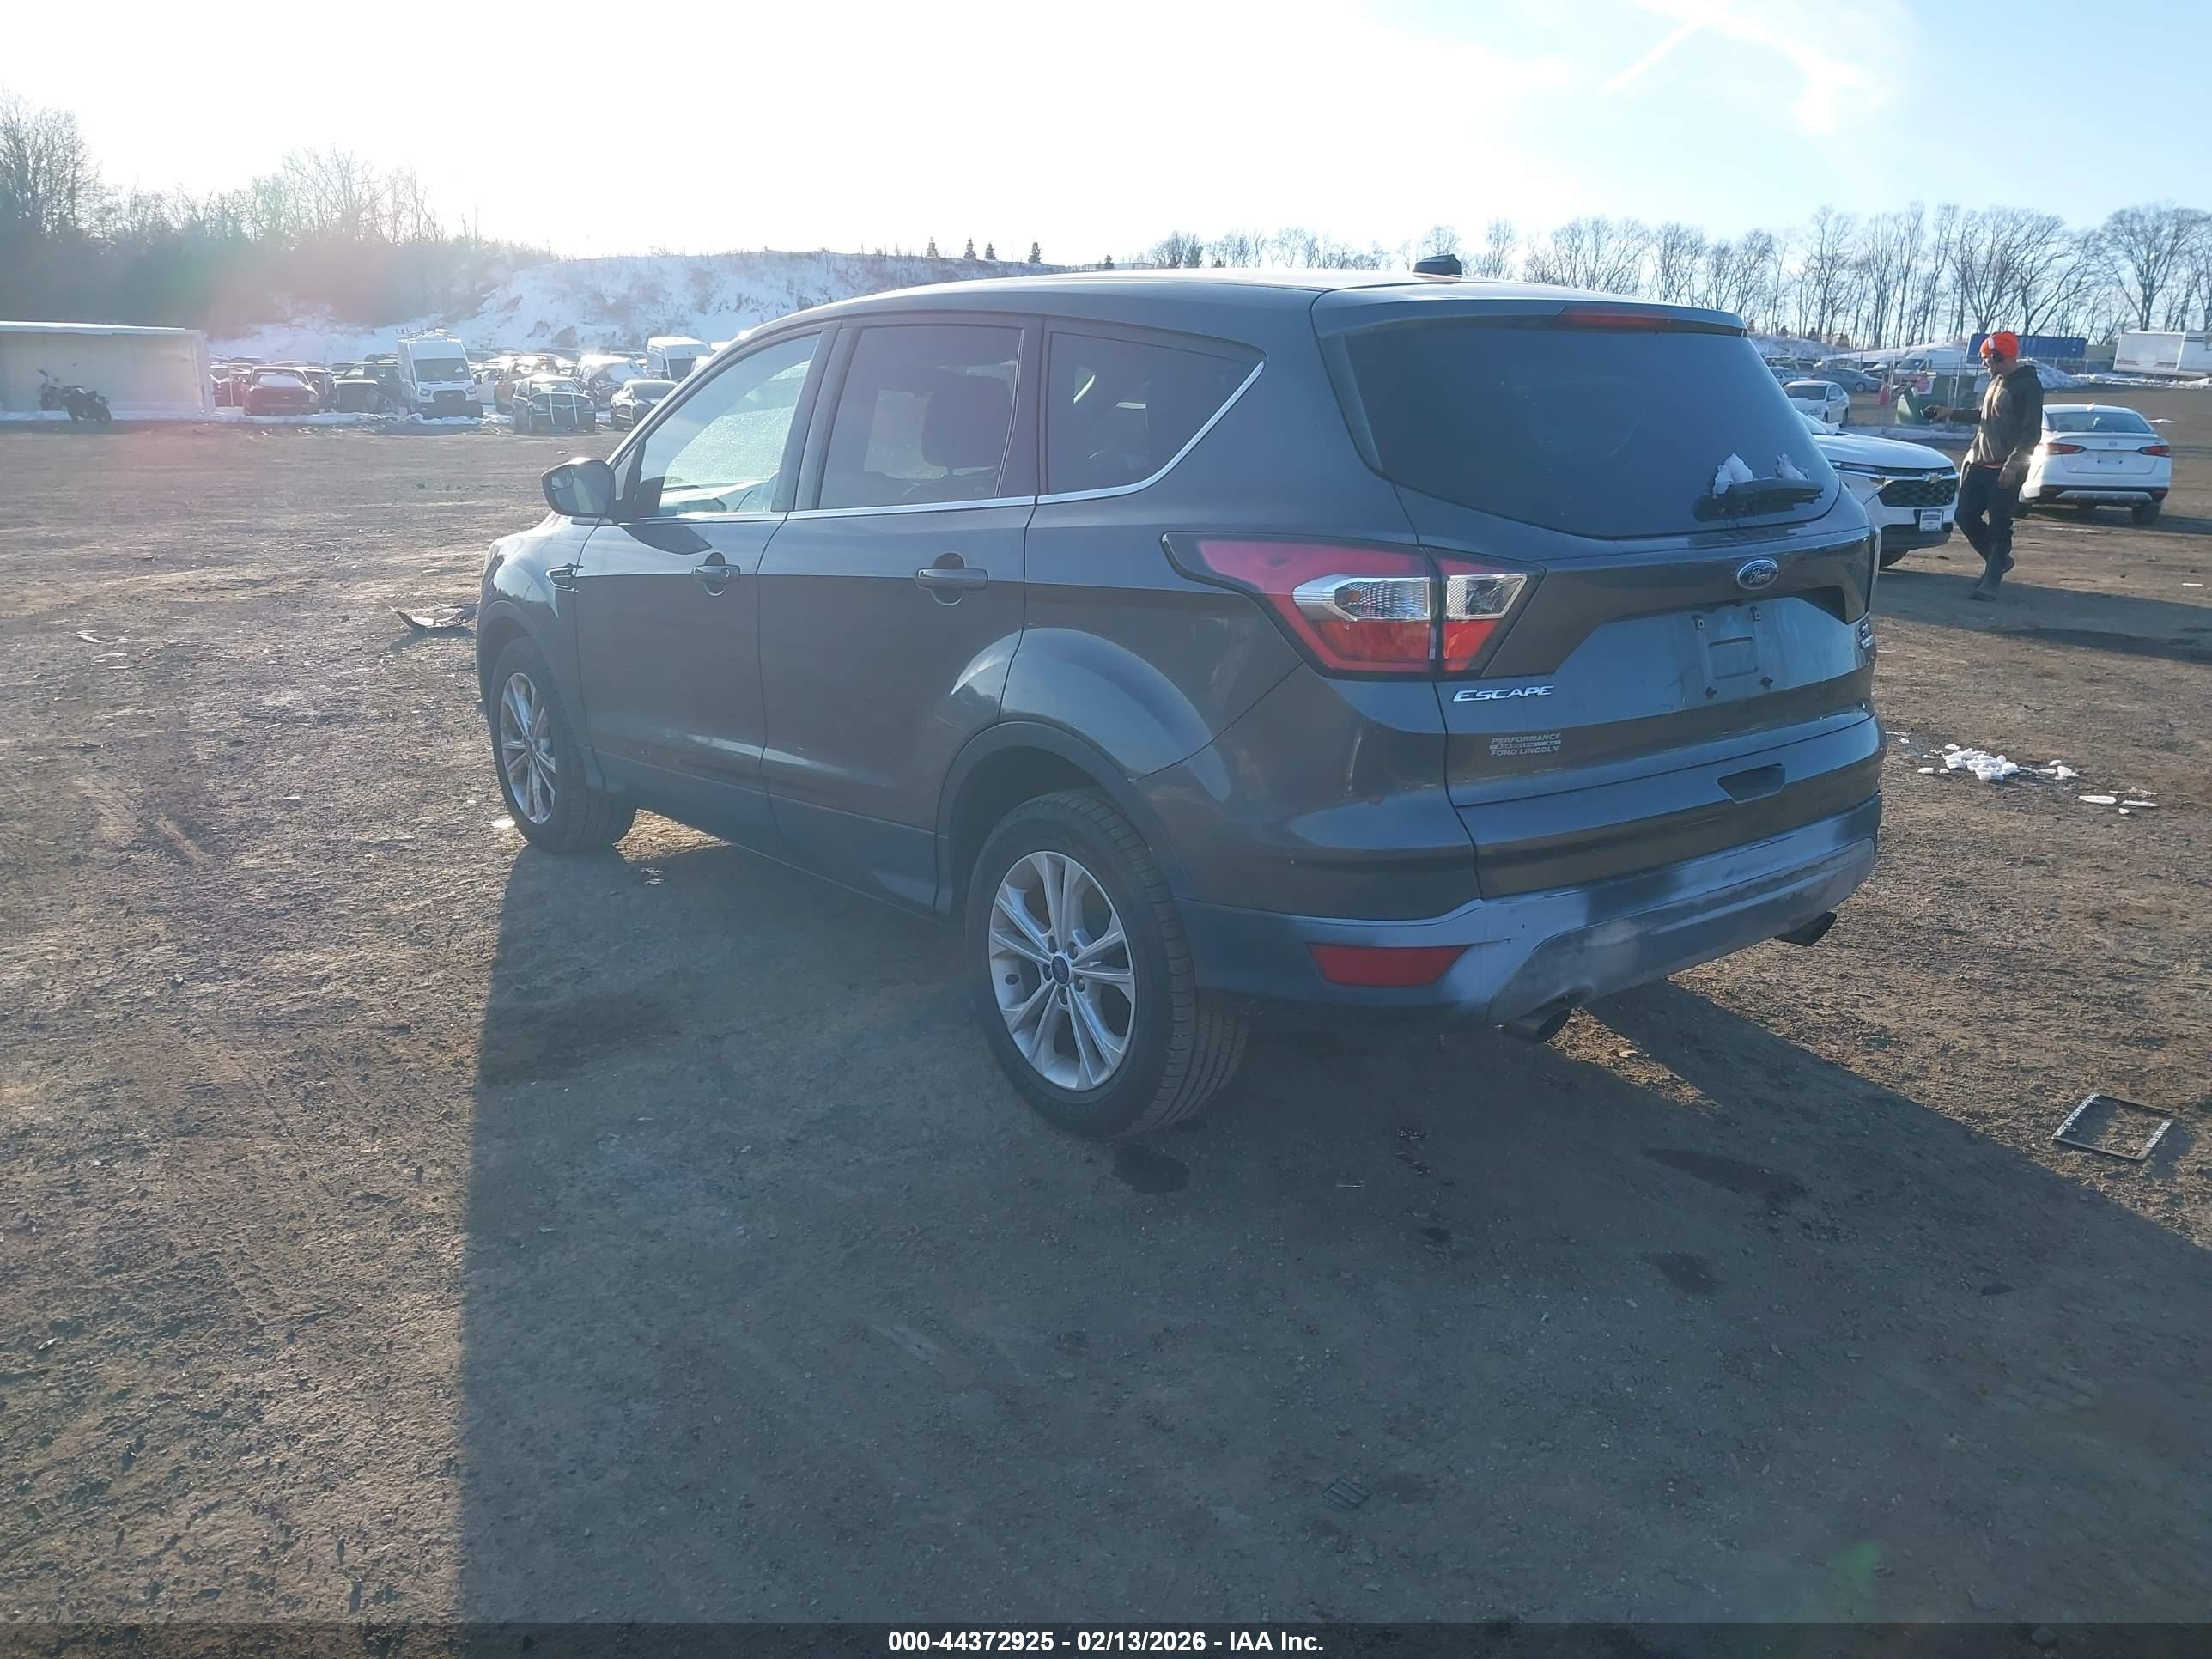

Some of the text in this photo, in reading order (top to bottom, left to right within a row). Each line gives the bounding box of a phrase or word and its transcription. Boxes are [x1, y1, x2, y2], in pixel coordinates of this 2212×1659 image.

[1748, 565, 1771, 584] Ford
[1453, 685, 1555, 702] ESCAPE
[1492, 733, 1561, 744] PERFORMANCE
[1491, 745, 1559, 757] FORD LINCOLN
